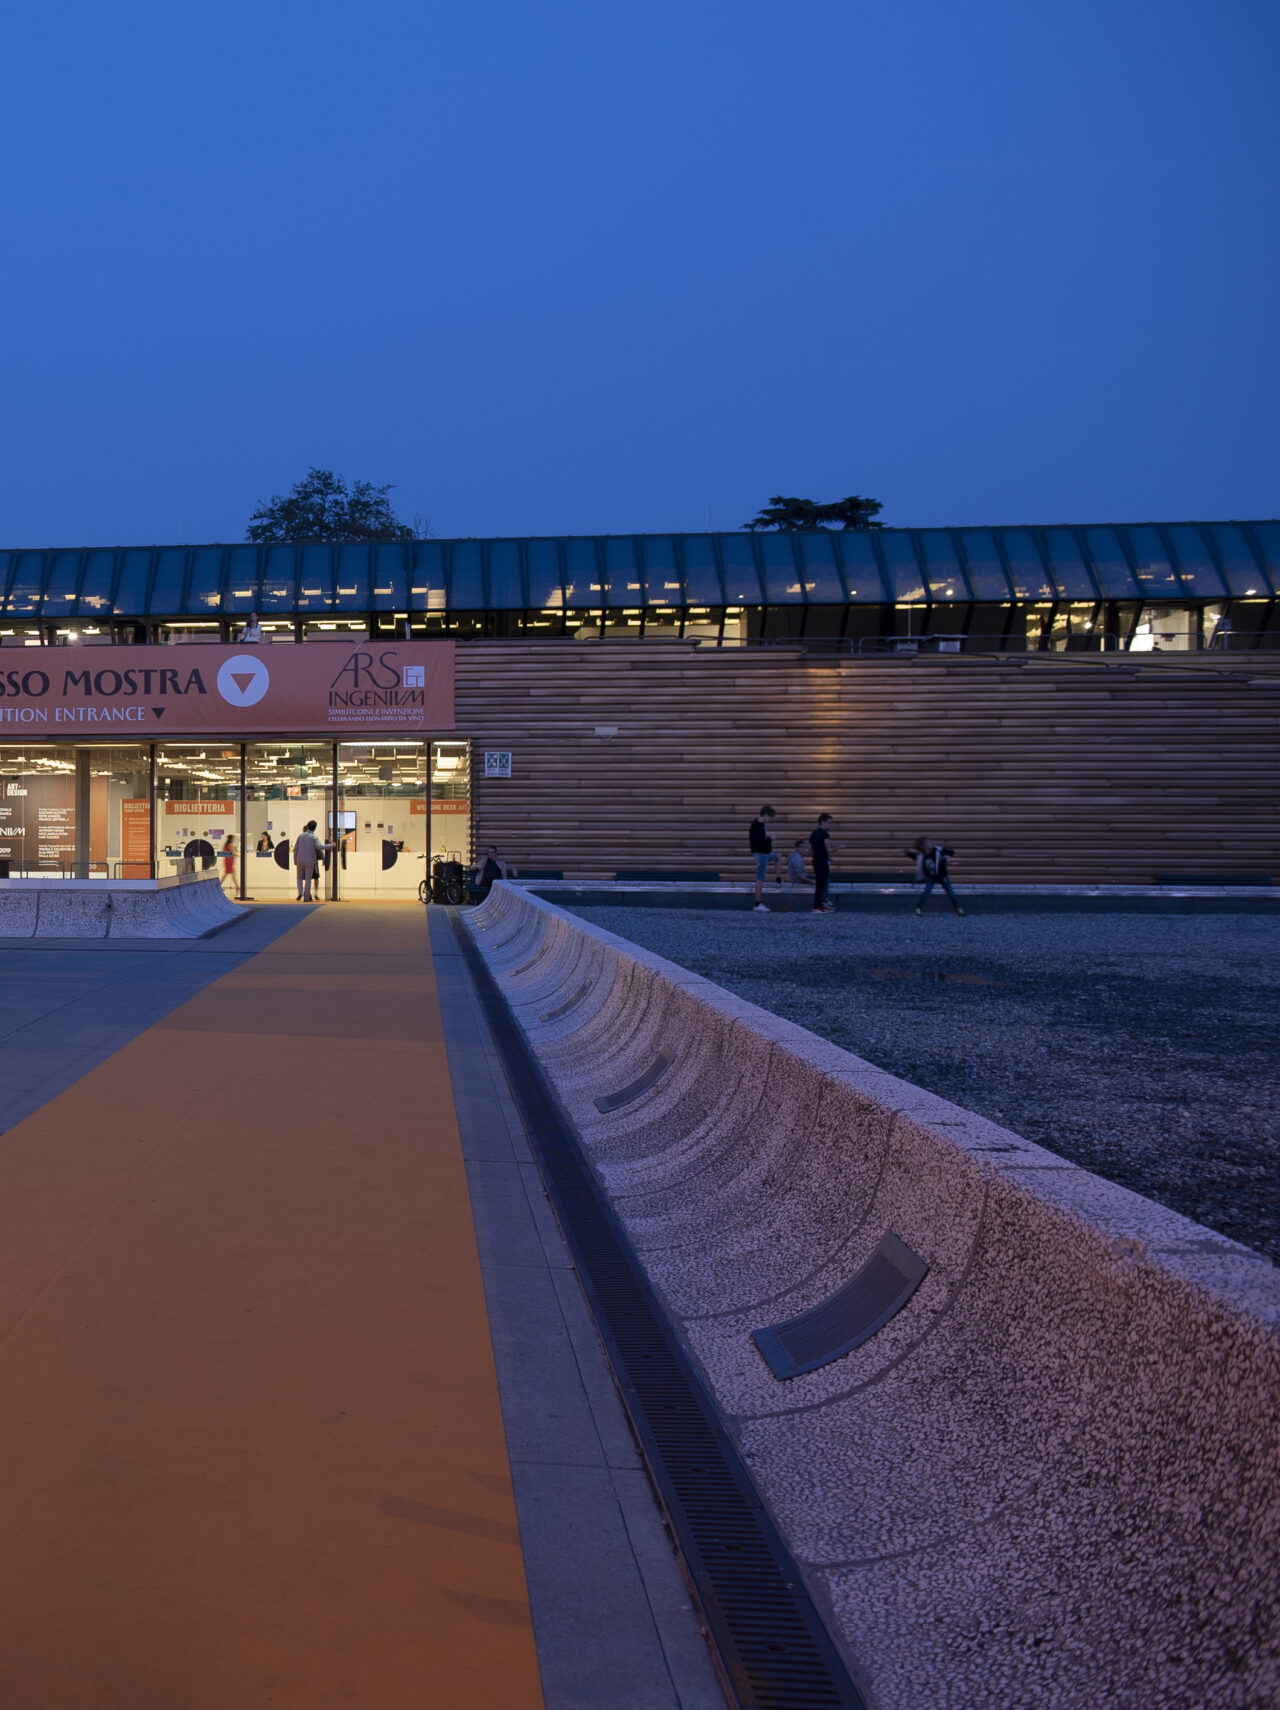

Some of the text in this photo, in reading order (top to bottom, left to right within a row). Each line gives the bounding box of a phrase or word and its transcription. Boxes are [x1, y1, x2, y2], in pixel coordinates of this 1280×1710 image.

[330, 651, 401, 690] ARS
[62, 668, 208, 697] MOSTRA
[55, 706, 145, 722] ENTRANCE
[381, 707, 425, 715] INVENZIONE
[174, 803, 226, 812] BIGLIETTERIA
